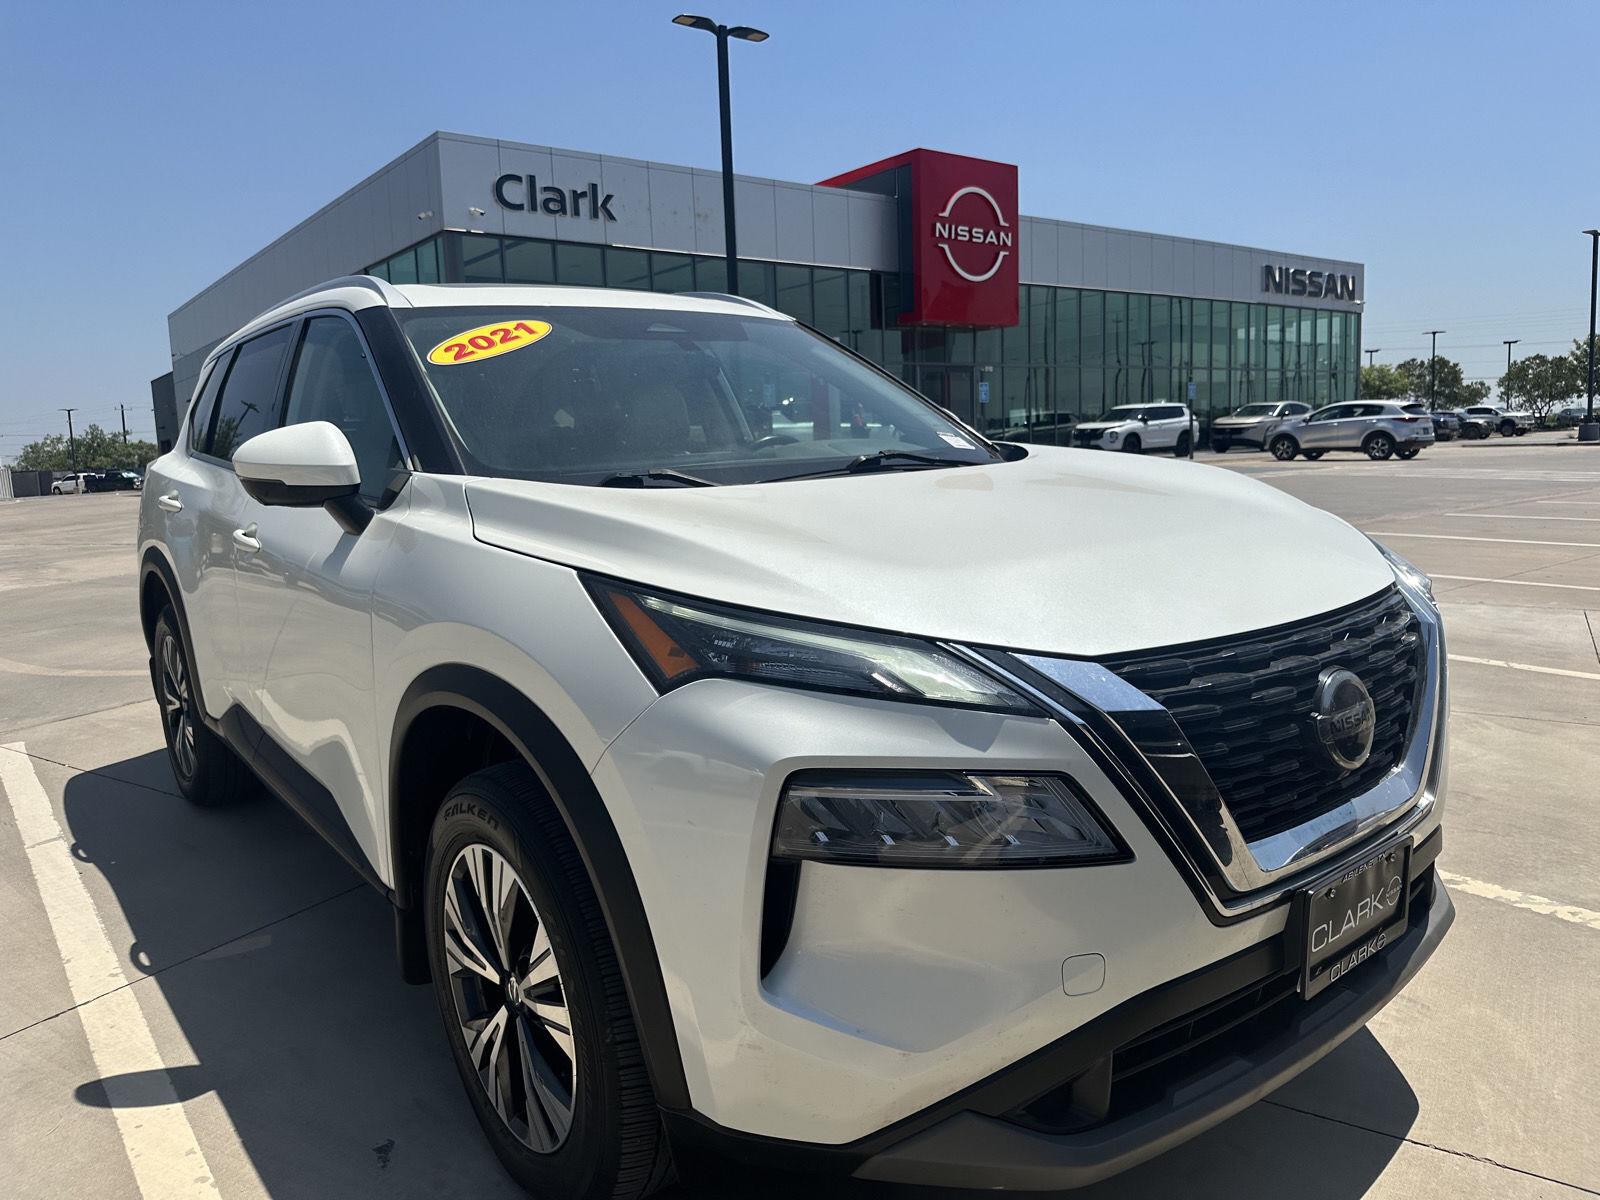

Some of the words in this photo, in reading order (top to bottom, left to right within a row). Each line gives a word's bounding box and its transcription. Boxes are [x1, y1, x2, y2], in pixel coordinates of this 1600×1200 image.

[494, 173, 617, 222] Clark
[934, 223, 1012, 247] NISSAN
[1264, 265, 1356, 300] NISSAN
[444, 322, 537, 361] 2021
[444, 802, 500, 830] FALKEN
[1311, 888, 1383, 952] CLARK
[1330, 940, 1377, 981] CLARK
